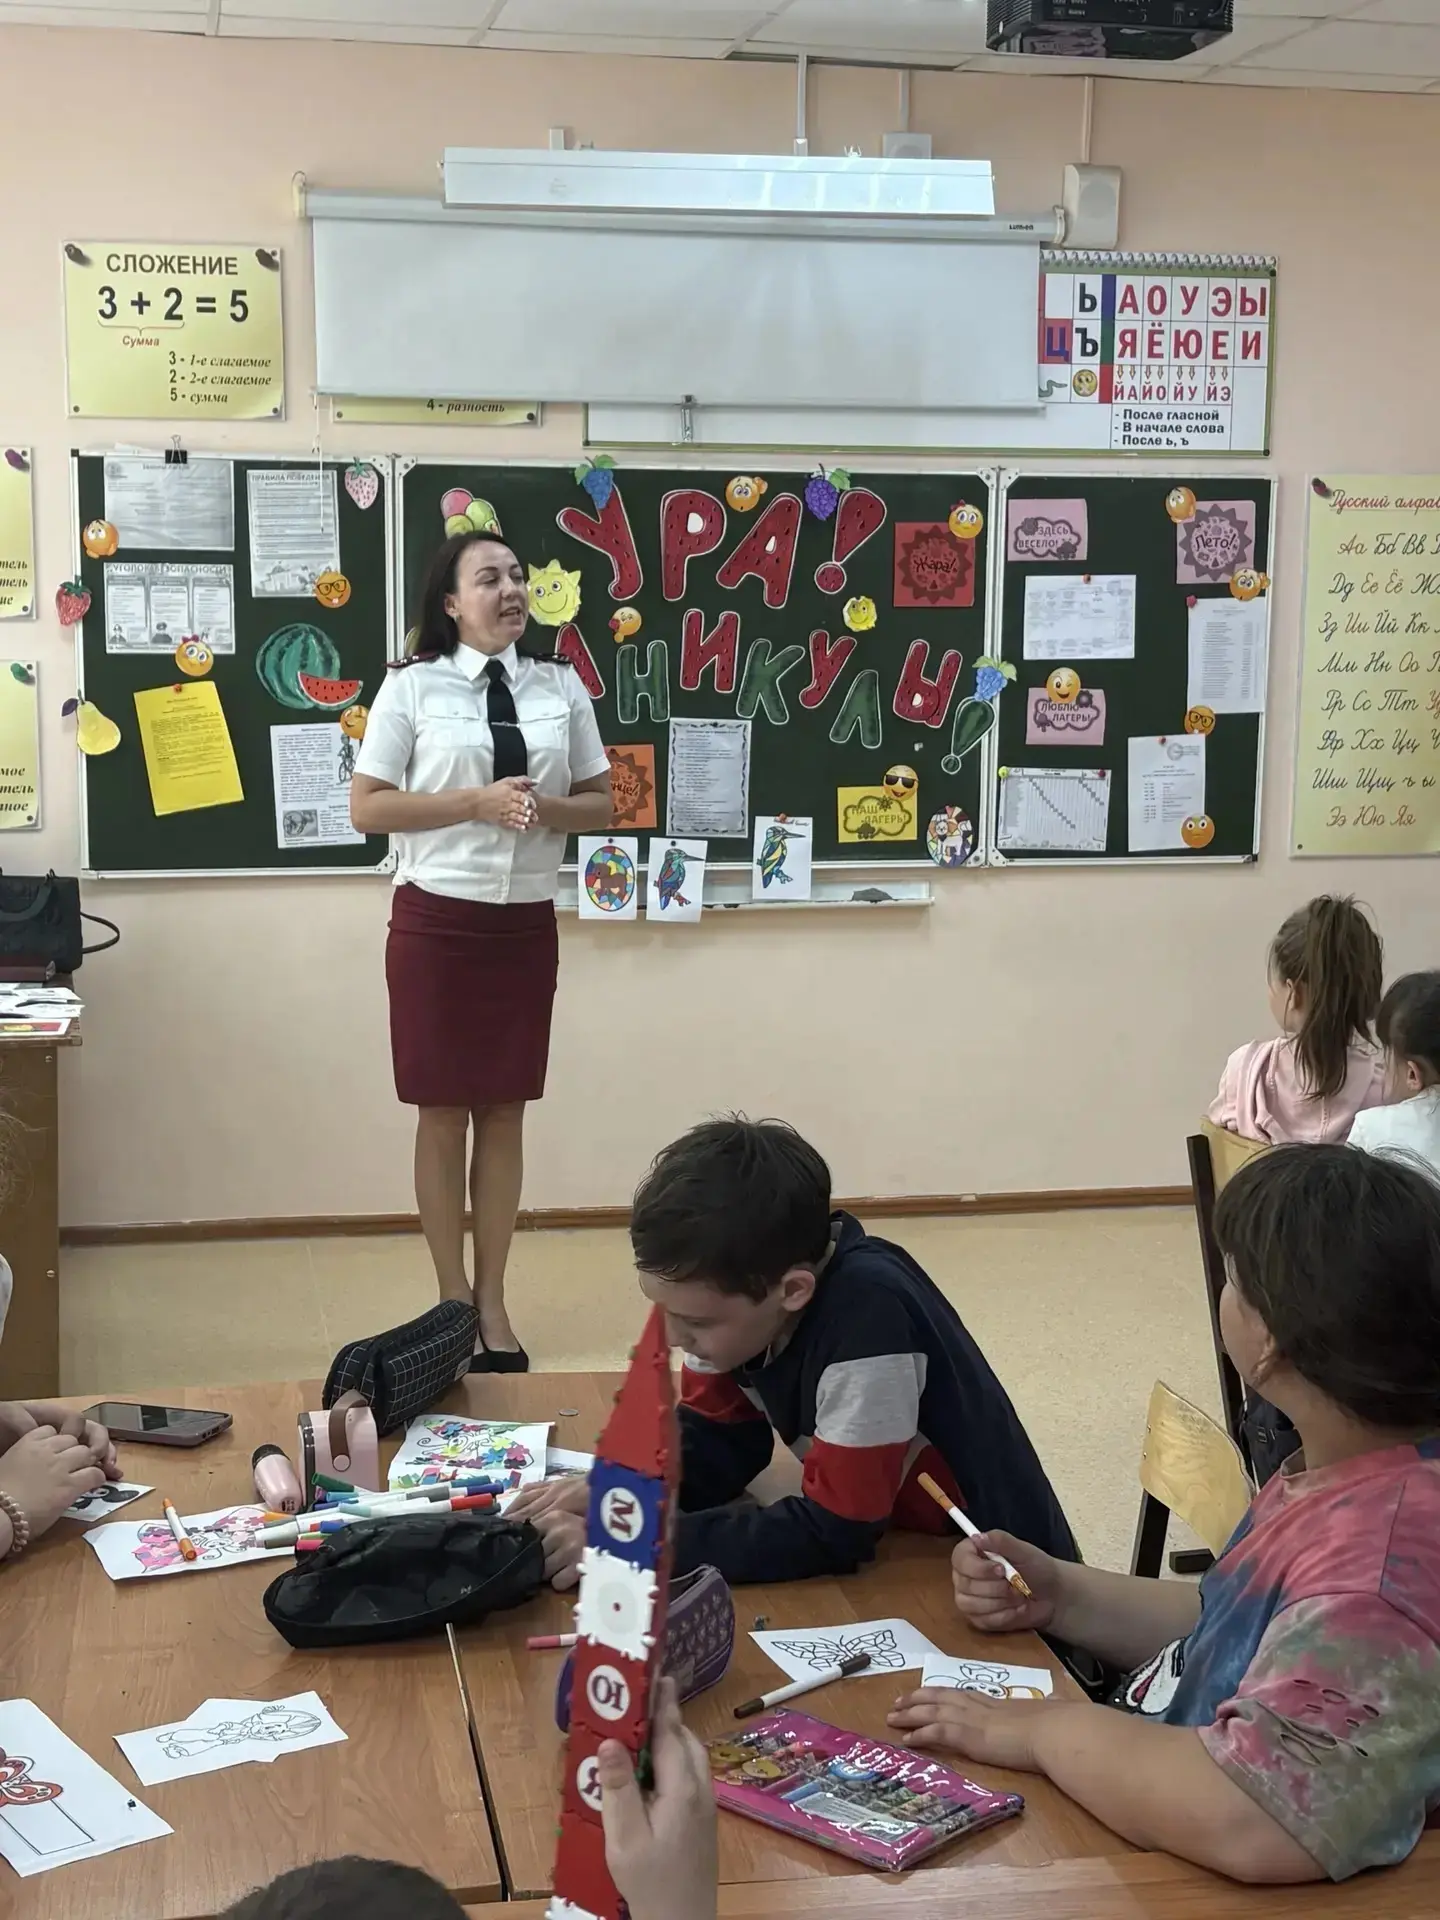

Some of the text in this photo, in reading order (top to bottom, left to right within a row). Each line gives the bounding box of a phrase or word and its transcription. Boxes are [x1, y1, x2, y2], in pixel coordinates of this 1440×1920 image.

[105, 253, 239, 275] СЛОЖЕНИЕ
[98, 286, 118, 320] 3
[163, 287, 184, 321] 2
[230, 289, 249, 323] 5
[122, 335, 160, 348] Сумма
[169, 350, 177, 365] 3
[210, 357, 271, 367] слагаемое
[169, 369, 177, 383] 2
[210, 375, 272, 386] слагаемое
[170, 387, 178, 402] 5
[190, 393, 228, 405] сумма
[446, 403, 505, 415] разность
[1123, 409, 1163, 420] После
[1167, 410, 1220, 421] гласной
[1123, 422, 1132, 433] В
[1135, 424, 1182, 433] начале
[1186, 424, 1225, 434] слова
[1122, 435, 1162, 446] После
[1328, 489, 1390, 515] Русский
[1038, 526, 1069, 537] ЗДЕСЬ
[556, 484, 887, 609] УРА!
[1195, 533, 1236, 552] Лето!
[1337, 533, 1368, 555] Аа
[1374, 532, 1406, 555] Бб
[1402, 533, 1427, 555] Вв
[913, 556, 957, 574] Жара!
[1328, 568, 1440, 603] Дд Ее Ёё Ж
[1318, 611, 1338, 642] Зз
[1345, 612, 1370, 634] Ии
[1374, 609, 1399, 634] Йй
[1405, 612, 1430, 634] Кк
[1317, 651, 1358, 673] Мм
[1364, 650, 1392, 673] Нн
[1399, 651, 1420, 673] Оо
[1041, 702, 1079, 712] ЛЮБЛЮ
[1321, 689, 1346, 720] Рр
[1352, 689, 1372, 711] Сс
[1378, 689, 1419, 711] Тт
[1052, 713, 1091, 722] ЛАГЕРЬ!
[1317, 729, 1344, 759] Фф
[1351, 728, 1385, 750] Хх
[1392, 728, 1420, 755] Цц
[1312, 768, 1348, 789] Шш
[1356, 767, 1396, 794] Щщ
[852, 805, 878, 815] НАШ
[865, 814, 907, 824] ЛАГЕРЬ!
[1326, 804, 1416, 827] Ээ Юю Яя
